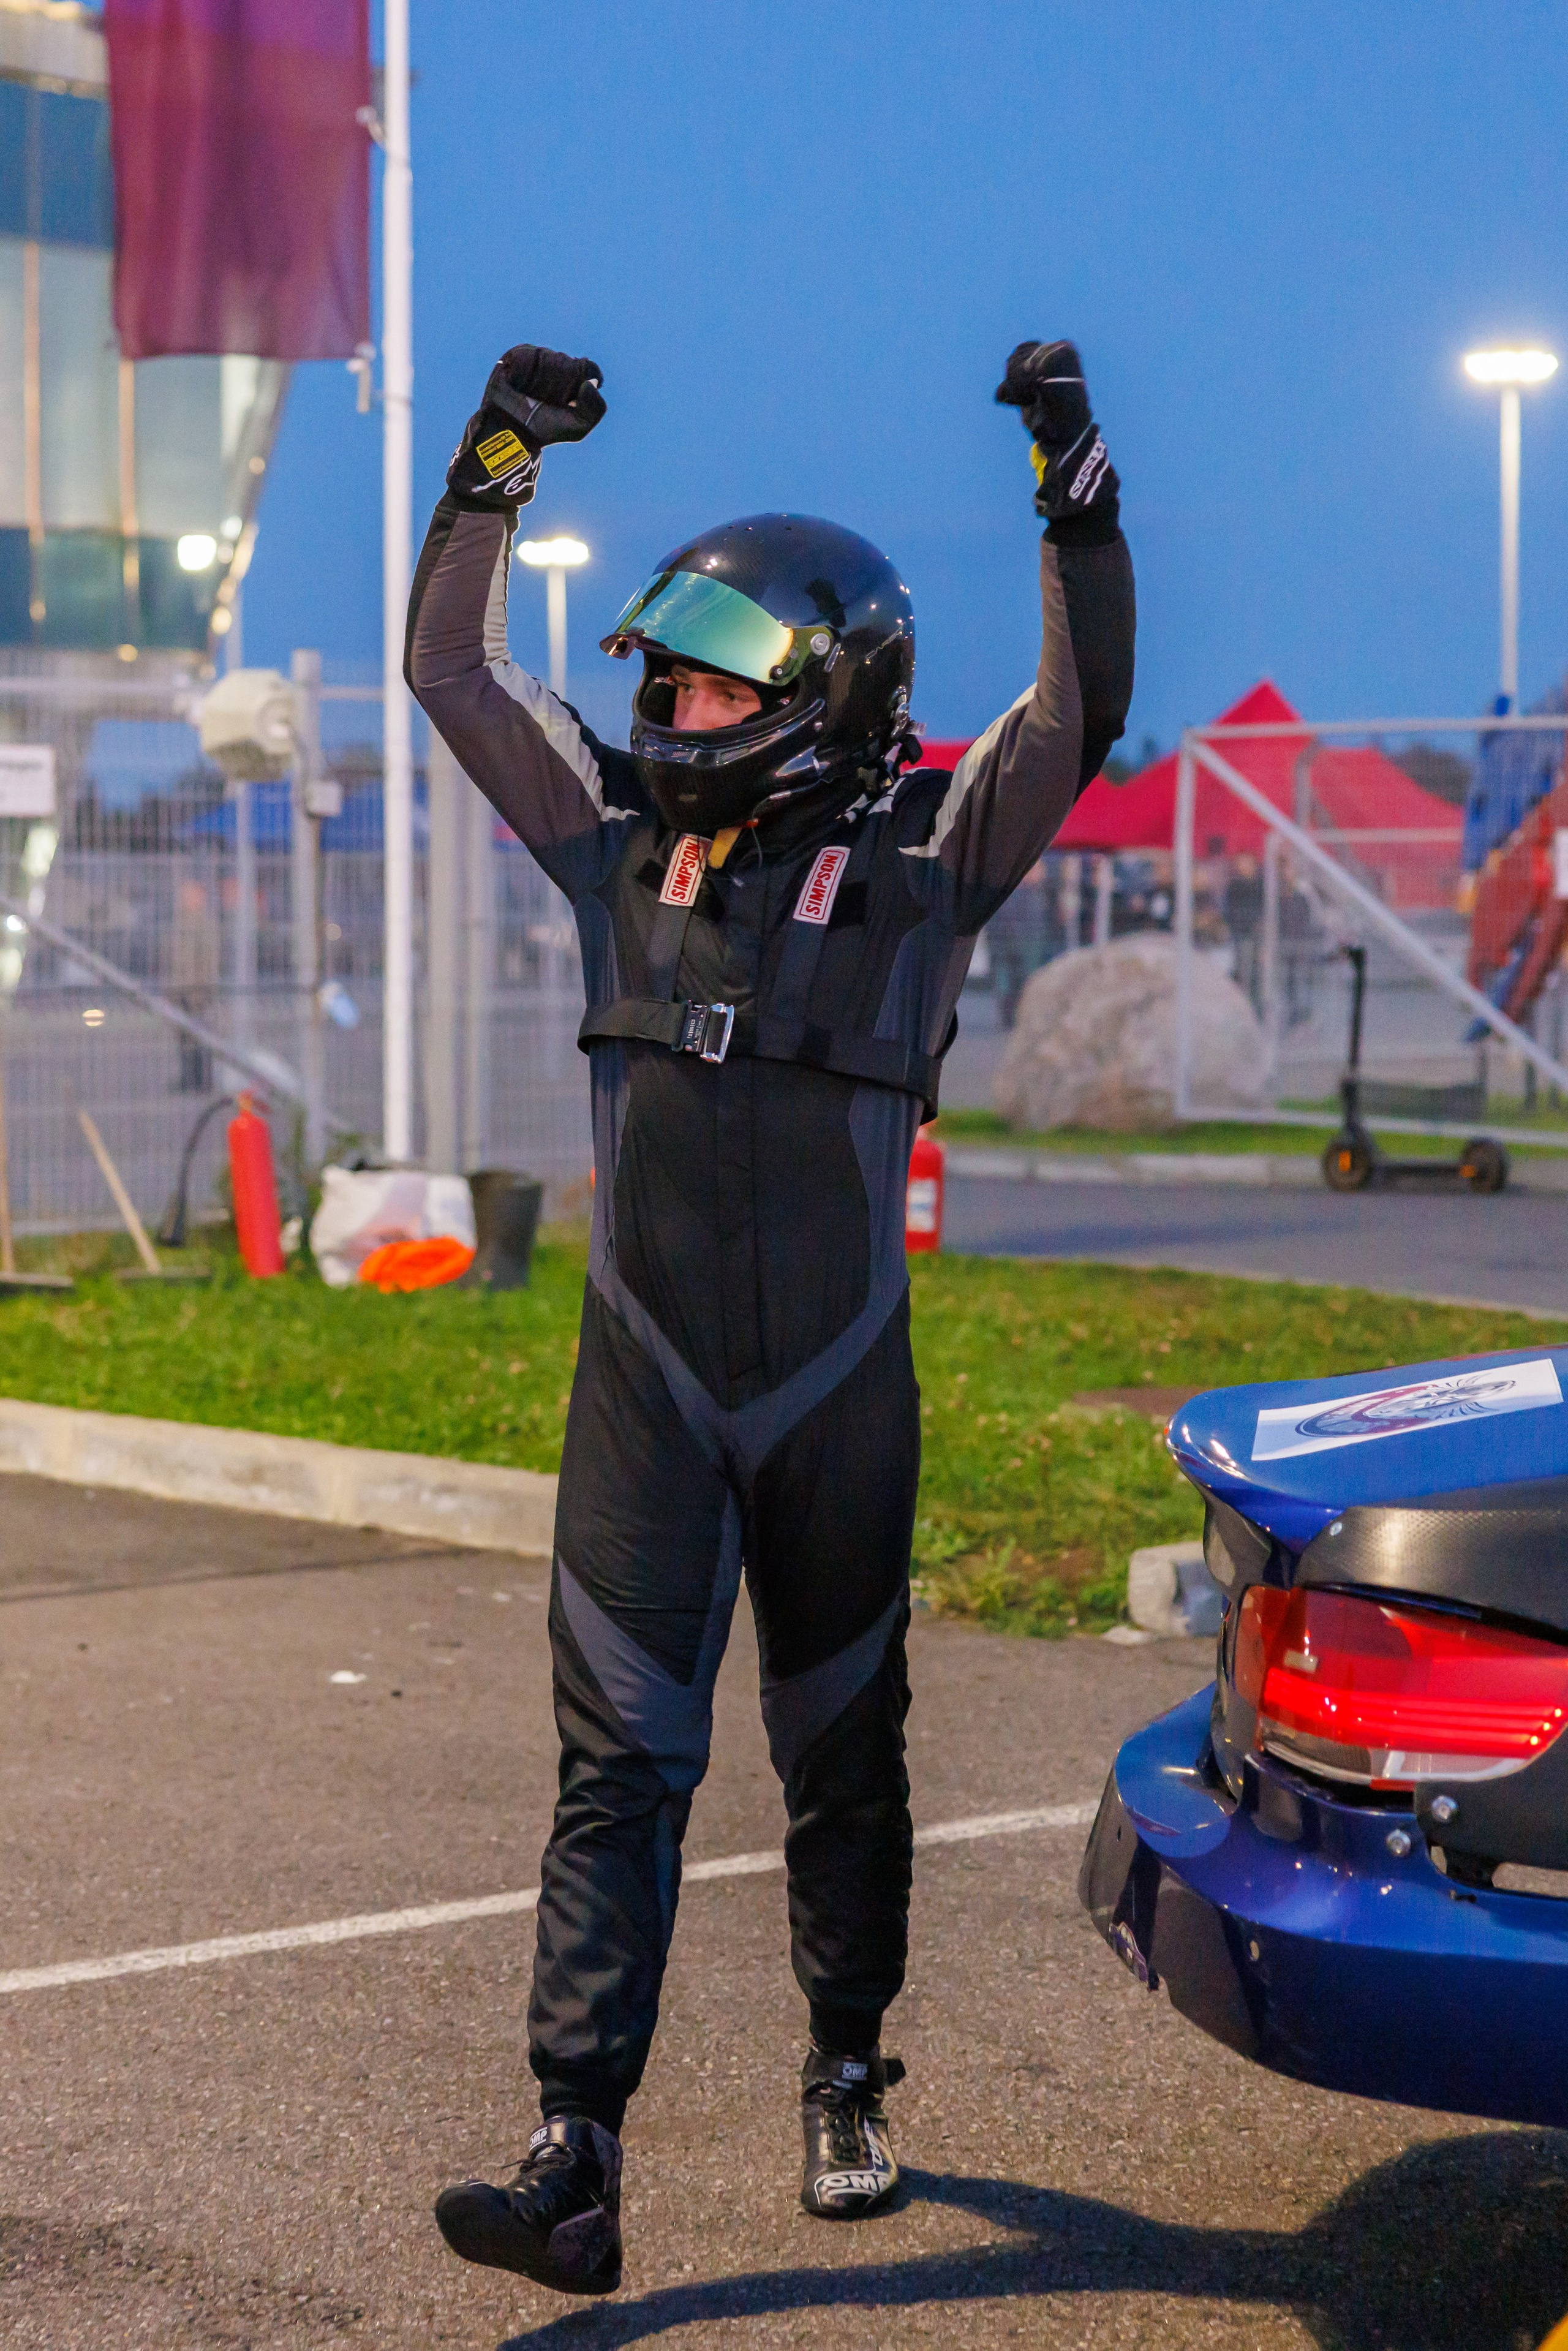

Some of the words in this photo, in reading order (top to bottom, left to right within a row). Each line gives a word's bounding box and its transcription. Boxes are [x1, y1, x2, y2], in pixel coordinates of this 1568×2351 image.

[671, 841, 701, 900] SIMPSON
[805, 855, 839, 915] SIMPSON
[843, 2064, 868, 2079] OMP
